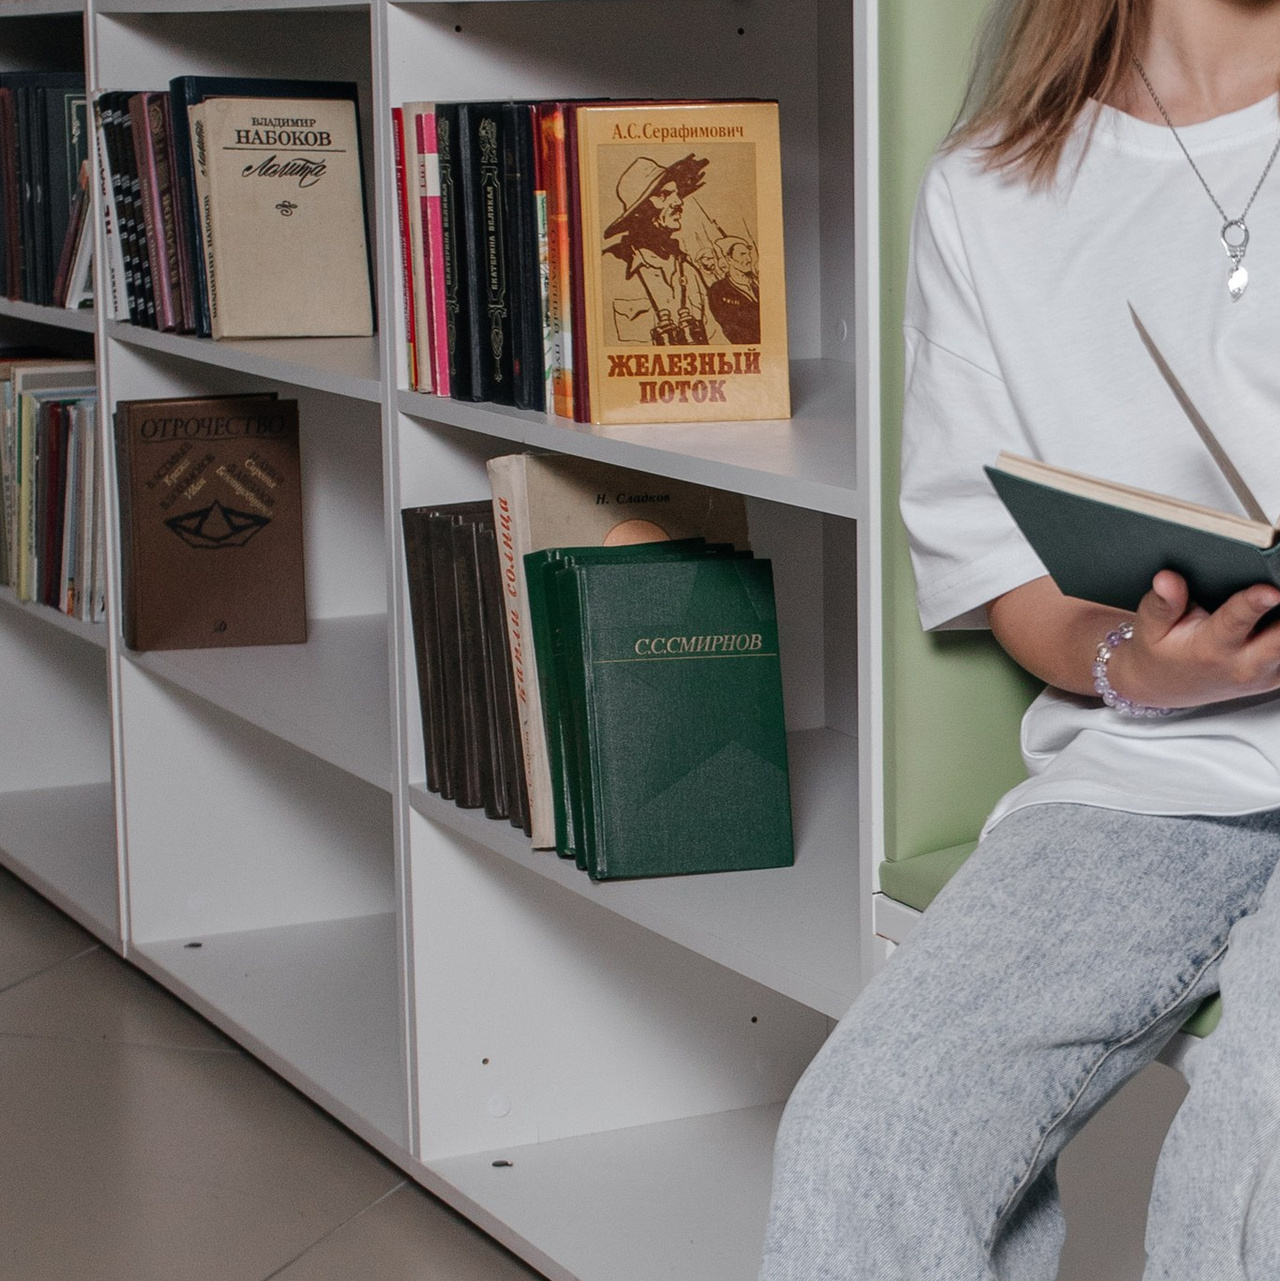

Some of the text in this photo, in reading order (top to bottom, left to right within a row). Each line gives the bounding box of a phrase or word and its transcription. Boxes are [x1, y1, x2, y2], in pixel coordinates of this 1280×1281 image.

[251, 117, 317, 128] ВЛАДИМИР
[235, 128, 332, 147] НАБОКОВ
[486, 186, 498, 291] ЕКАТЕРИНА ВЕЛИКАЯ
[607, 348, 761, 378] ЖЕЛЕЗНЫЙ
[639, 379, 726, 405] ПОТОК
[141, 415, 285, 439] ОТРОЧЕСТВО
[596, 491, 671, 506] Н. Сладков
[497, 496, 519, 598] солнца
